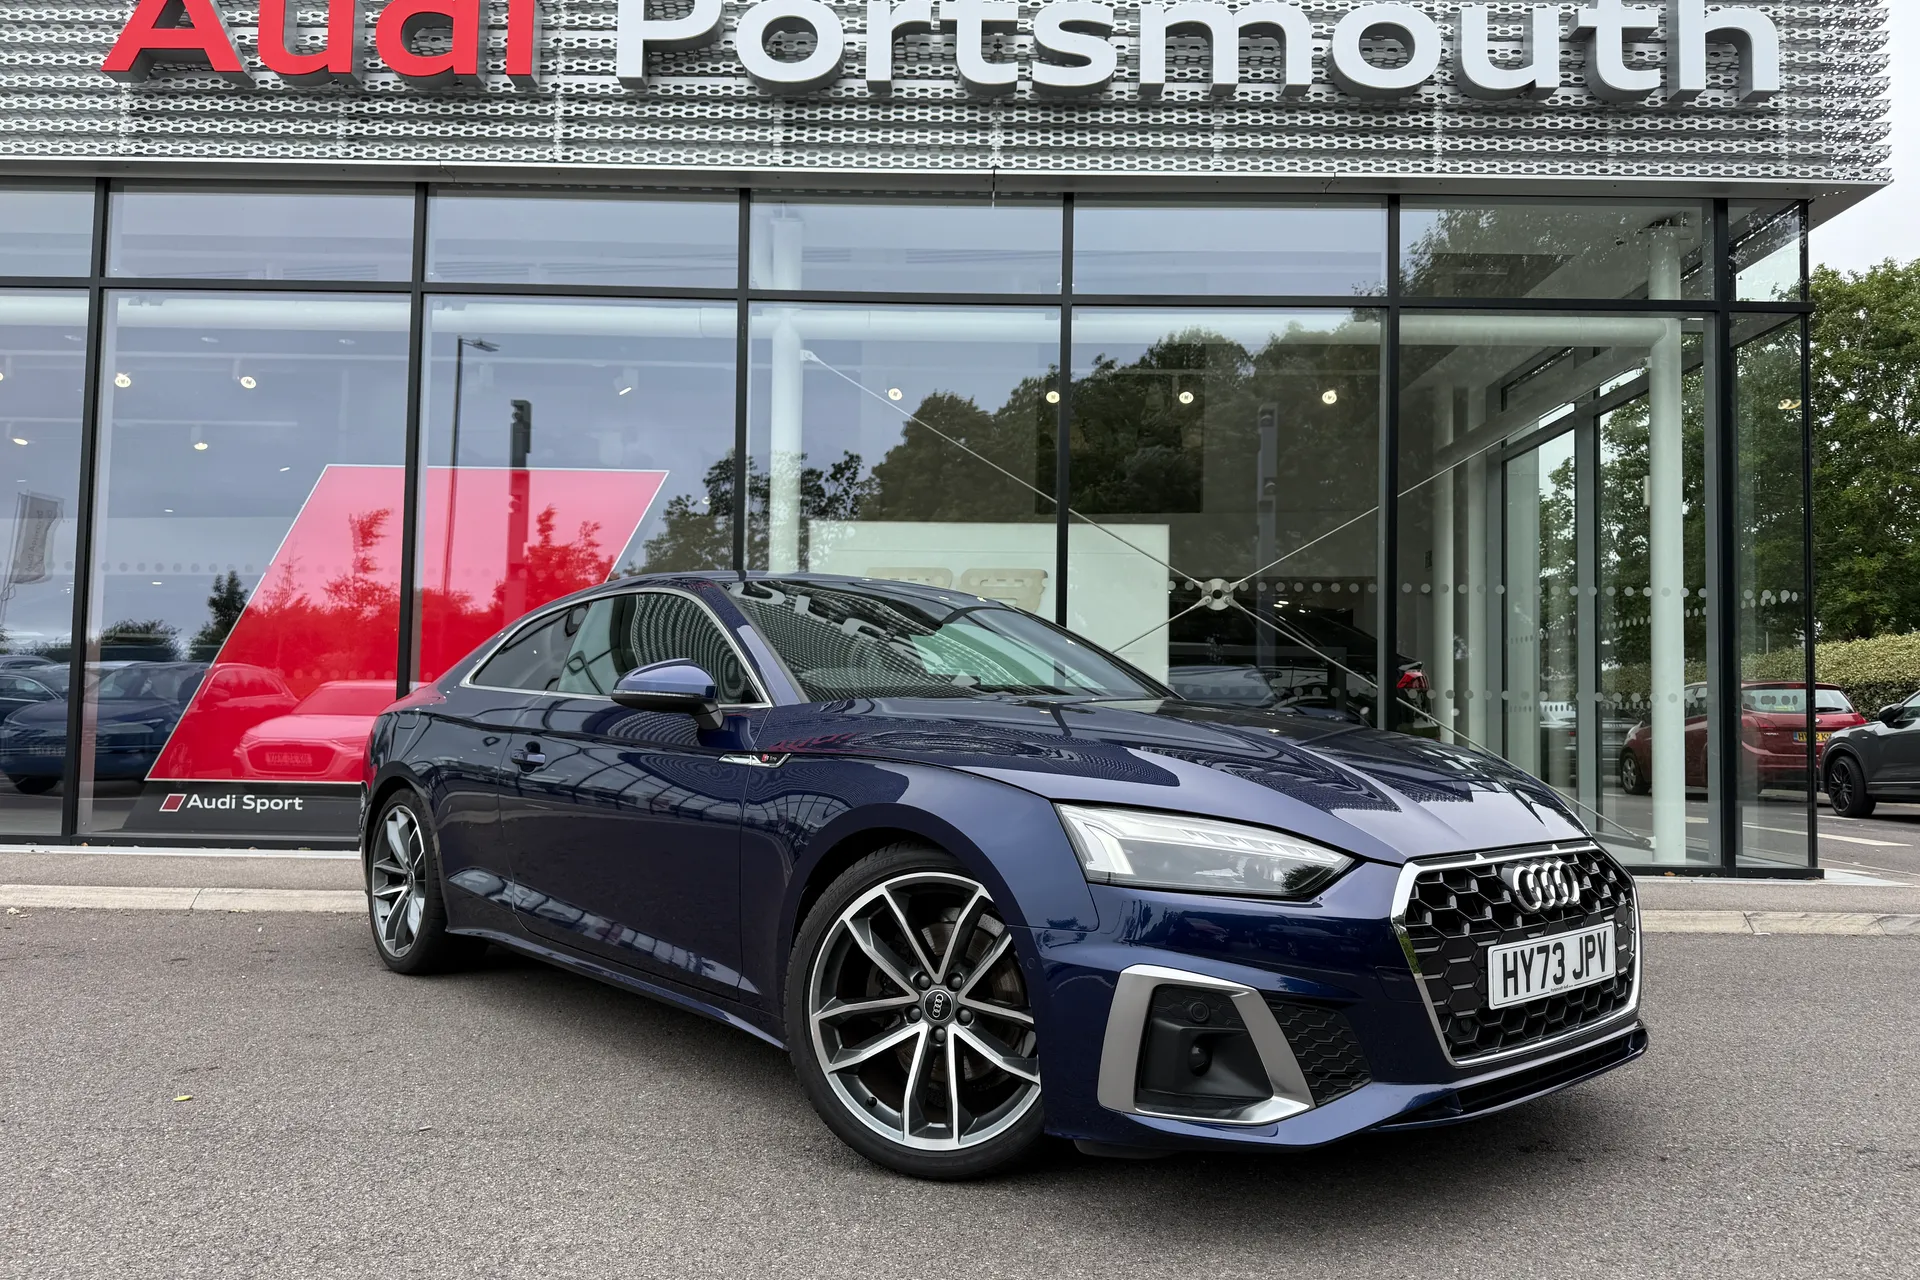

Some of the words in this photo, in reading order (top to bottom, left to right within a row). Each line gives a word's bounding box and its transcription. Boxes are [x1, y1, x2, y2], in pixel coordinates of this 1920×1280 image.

[616, 0, 1780, 96] Portsmouth
[186, 793, 236, 809] Audi
[242, 794, 304, 814] Sport
[1502, 941, 1566, 998] HY73
[1572, 930, 1608, 980] JPV
